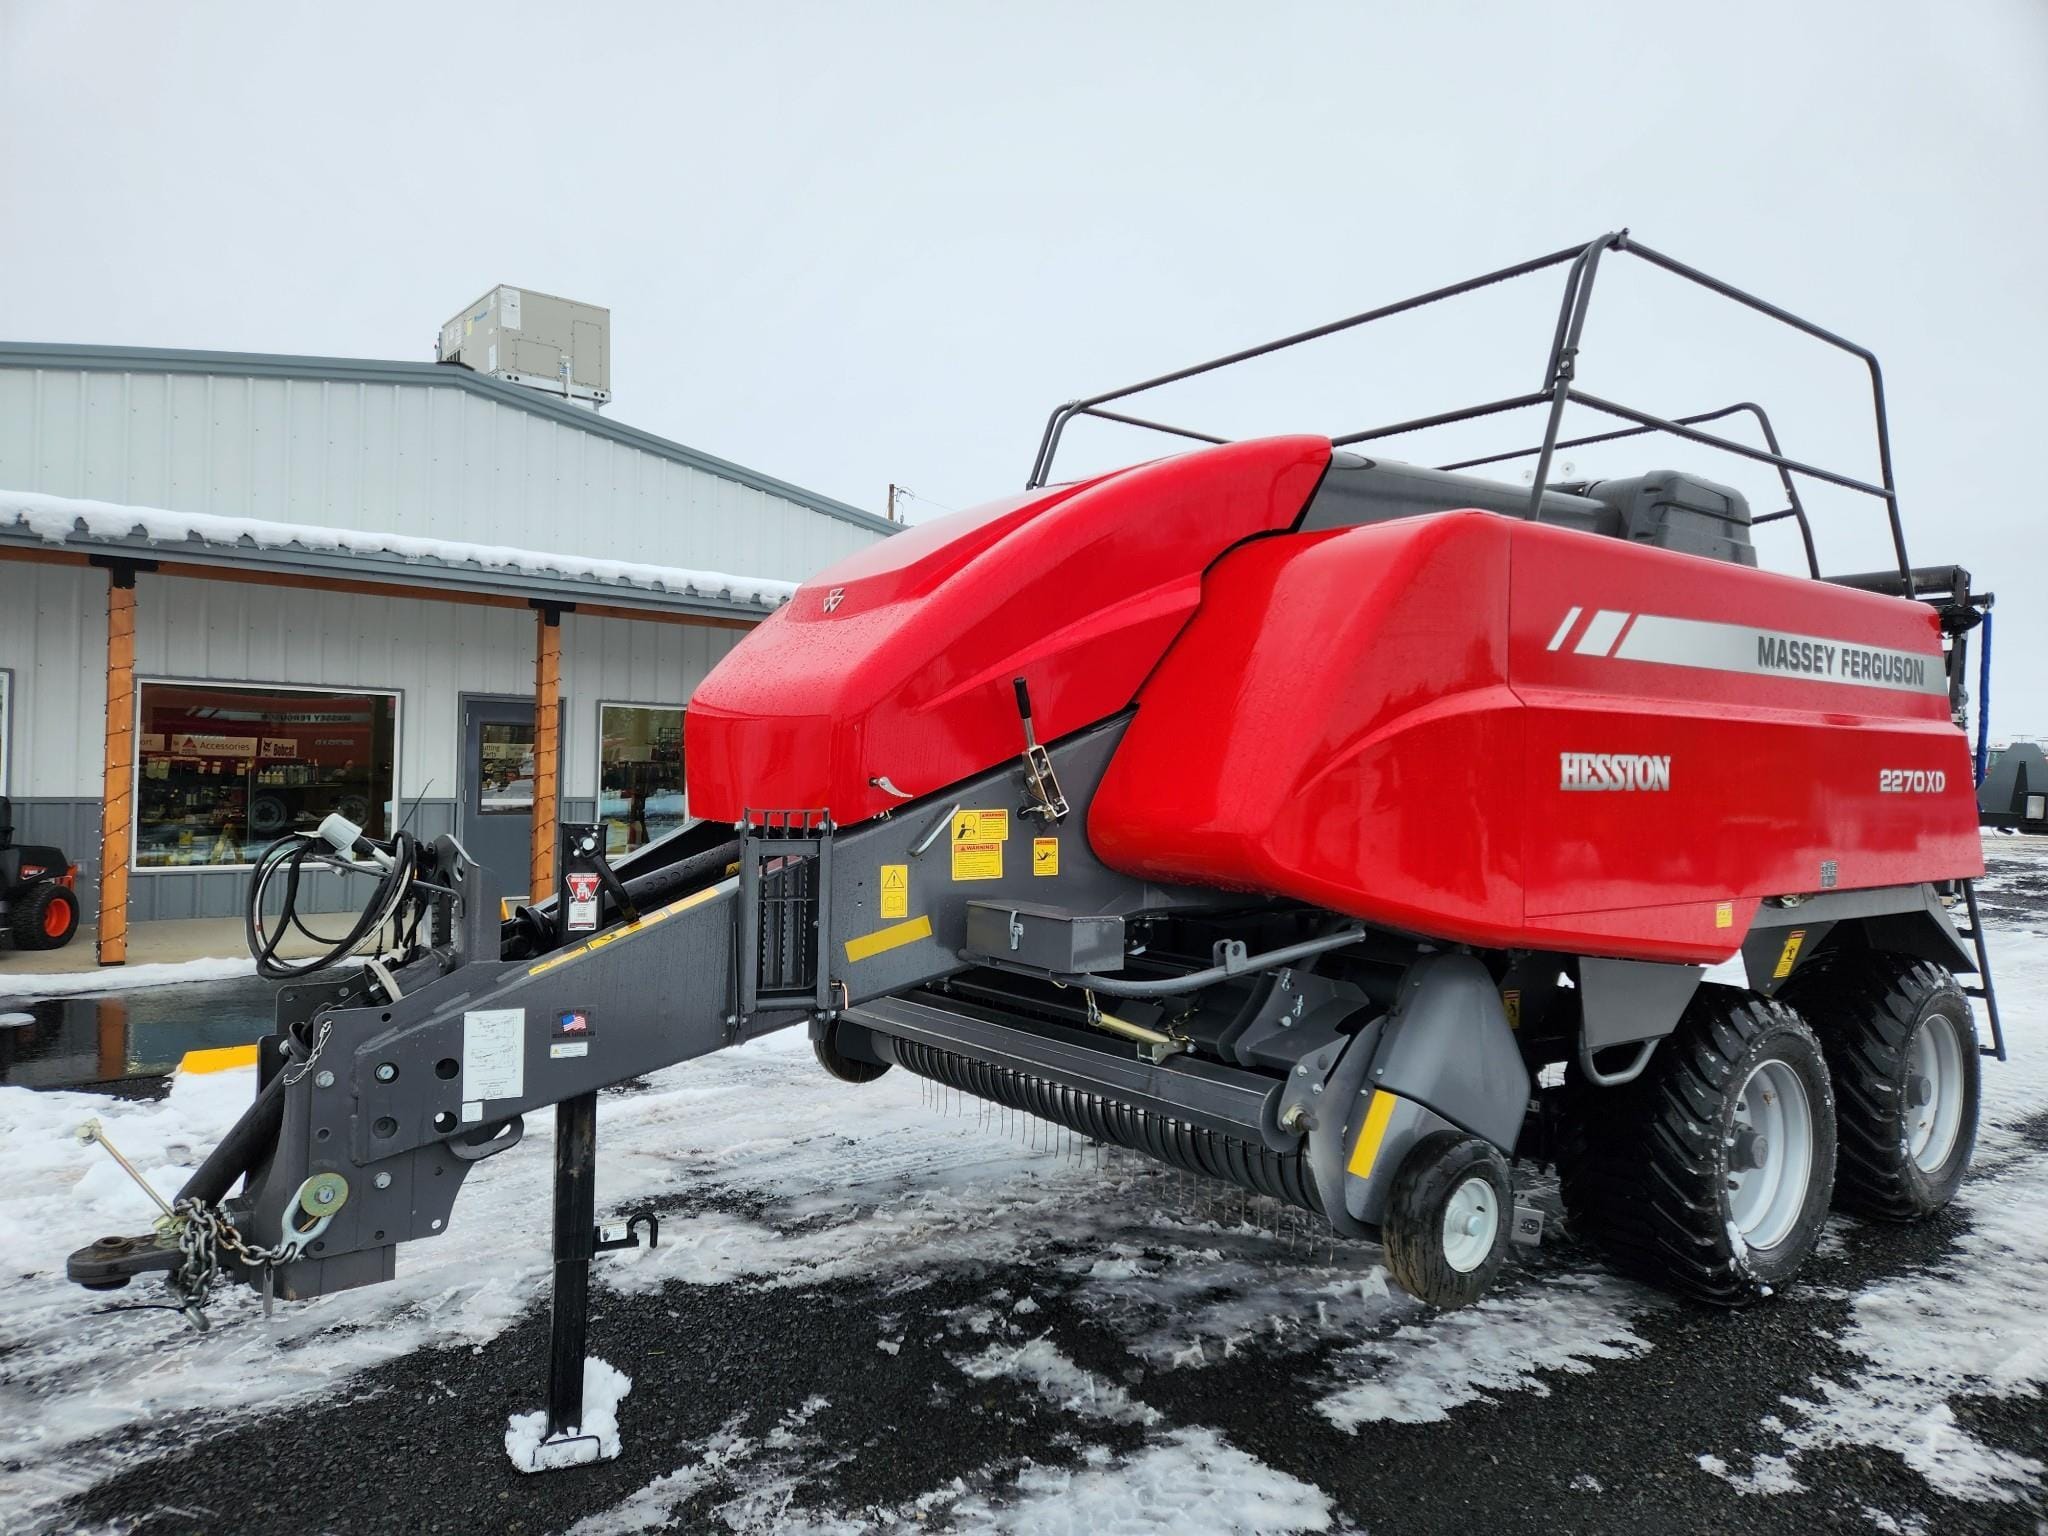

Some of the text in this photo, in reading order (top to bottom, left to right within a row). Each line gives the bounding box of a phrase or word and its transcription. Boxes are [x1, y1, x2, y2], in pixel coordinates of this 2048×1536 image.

[1757, 636, 1925, 686] MASSEY FERGUSON
[199, 741, 250, 751] Accessories
[273, 743, 295, 756] Bobcat
[1560, 752, 1671, 792] HESSTON
[1879, 768, 1946, 793] 2270XD
